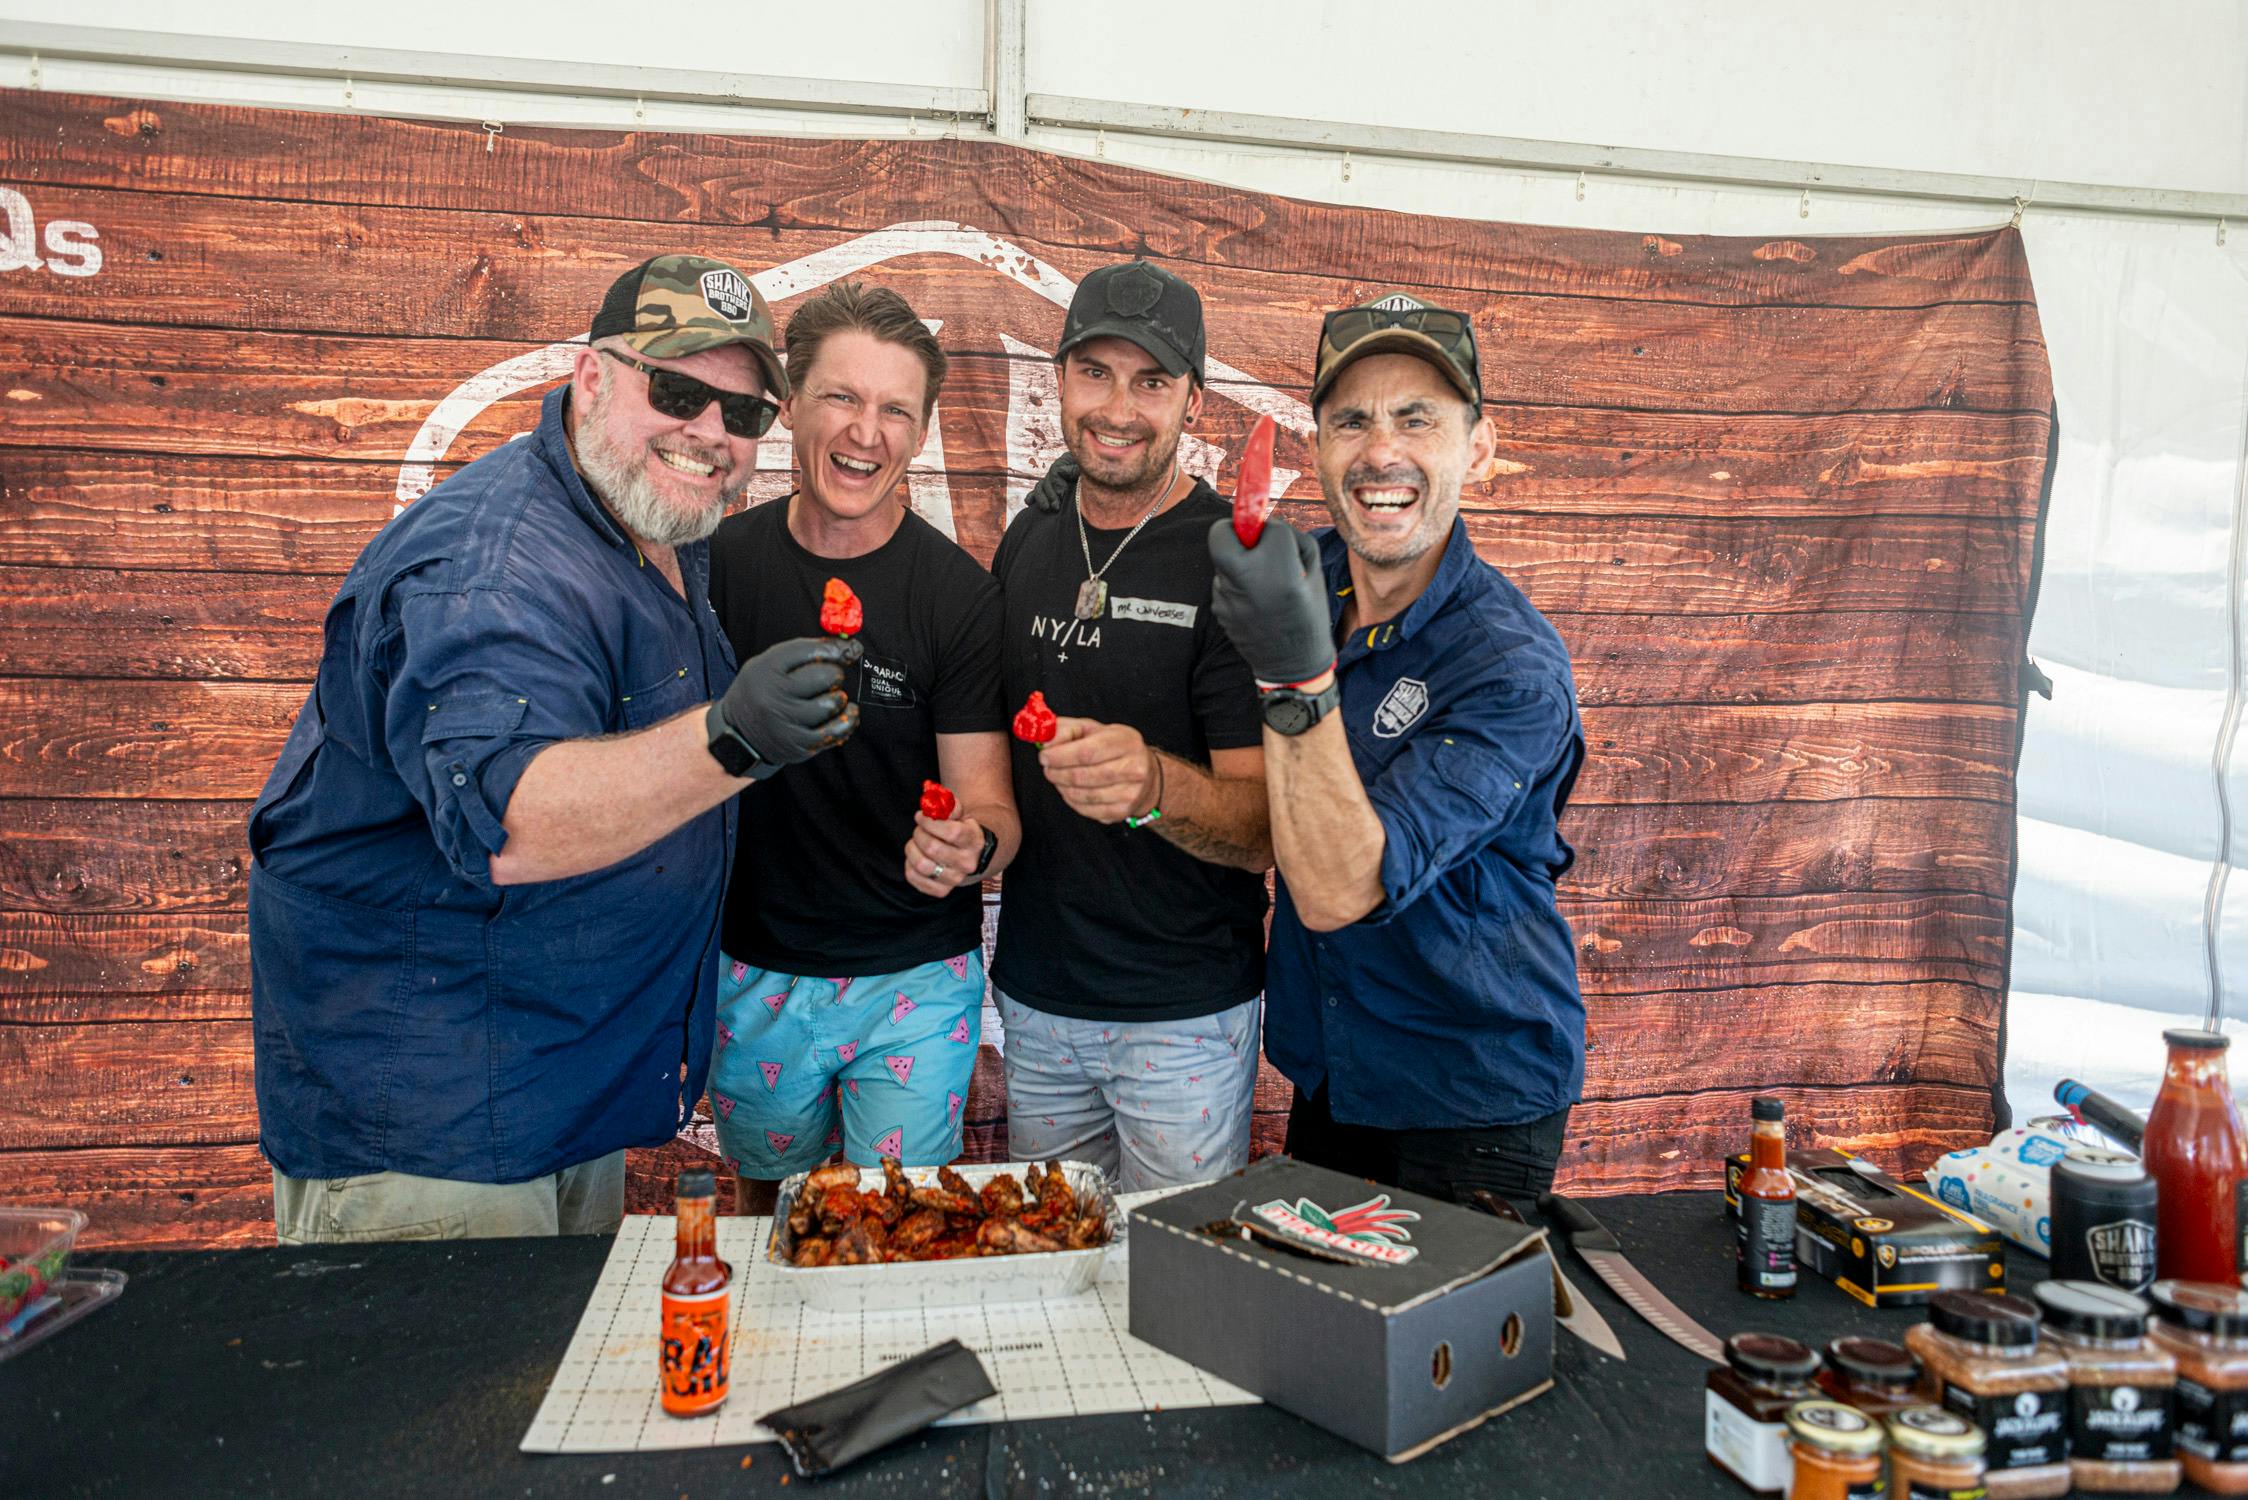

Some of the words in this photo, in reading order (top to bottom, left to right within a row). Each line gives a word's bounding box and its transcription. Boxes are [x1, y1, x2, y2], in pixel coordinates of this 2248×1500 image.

[706, 272, 749, 303] SHANK
[708, 288, 748, 311] BROTHERS
[1031, 615, 1101, 648] NY/LA
